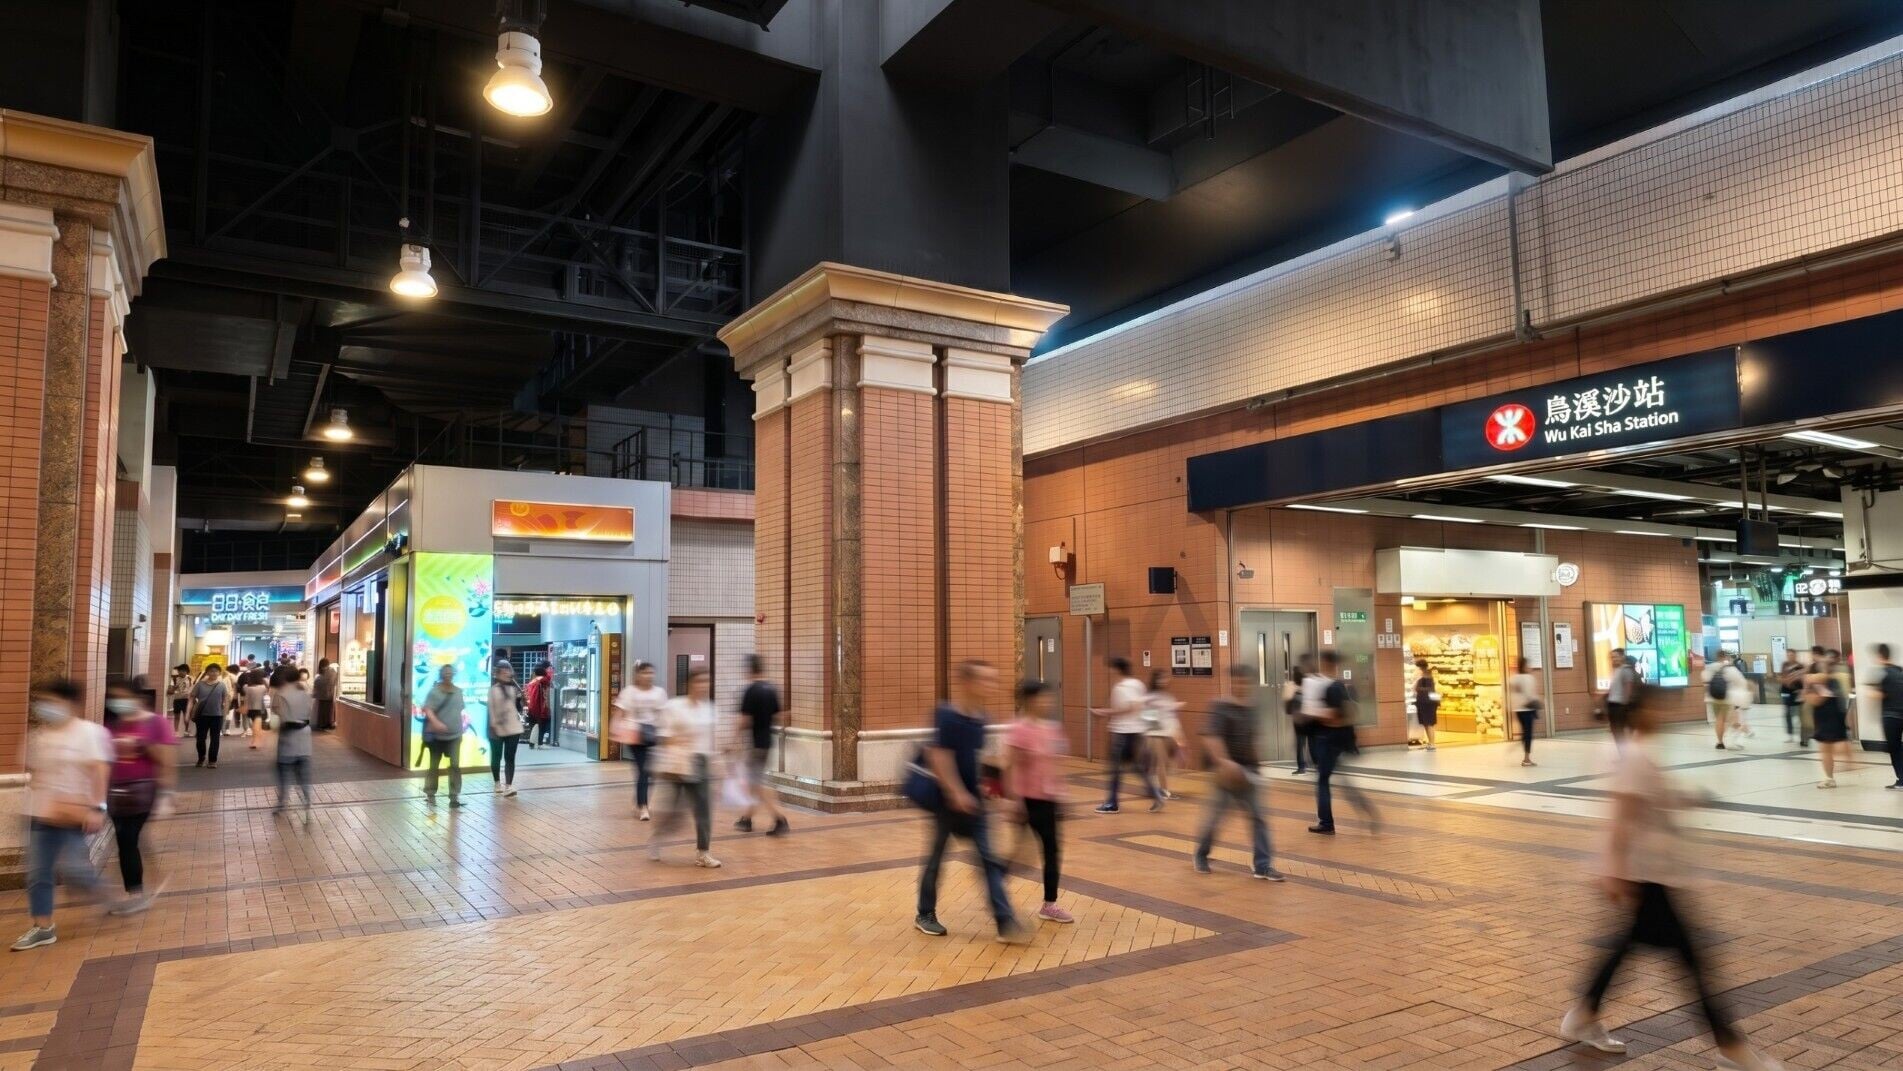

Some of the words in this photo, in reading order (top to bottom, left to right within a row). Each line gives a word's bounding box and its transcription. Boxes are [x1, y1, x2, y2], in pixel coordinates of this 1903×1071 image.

[1545, 376, 1665, 425] 烏溪沙站
[1544, 430, 1567, 444] Wu
[1570, 425, 1592, 440] Kai
[1595, 420, 1622, 436] Sha
[1624, 411, 1679, 431] Station
[243, 612, 268, 621] FRESH
